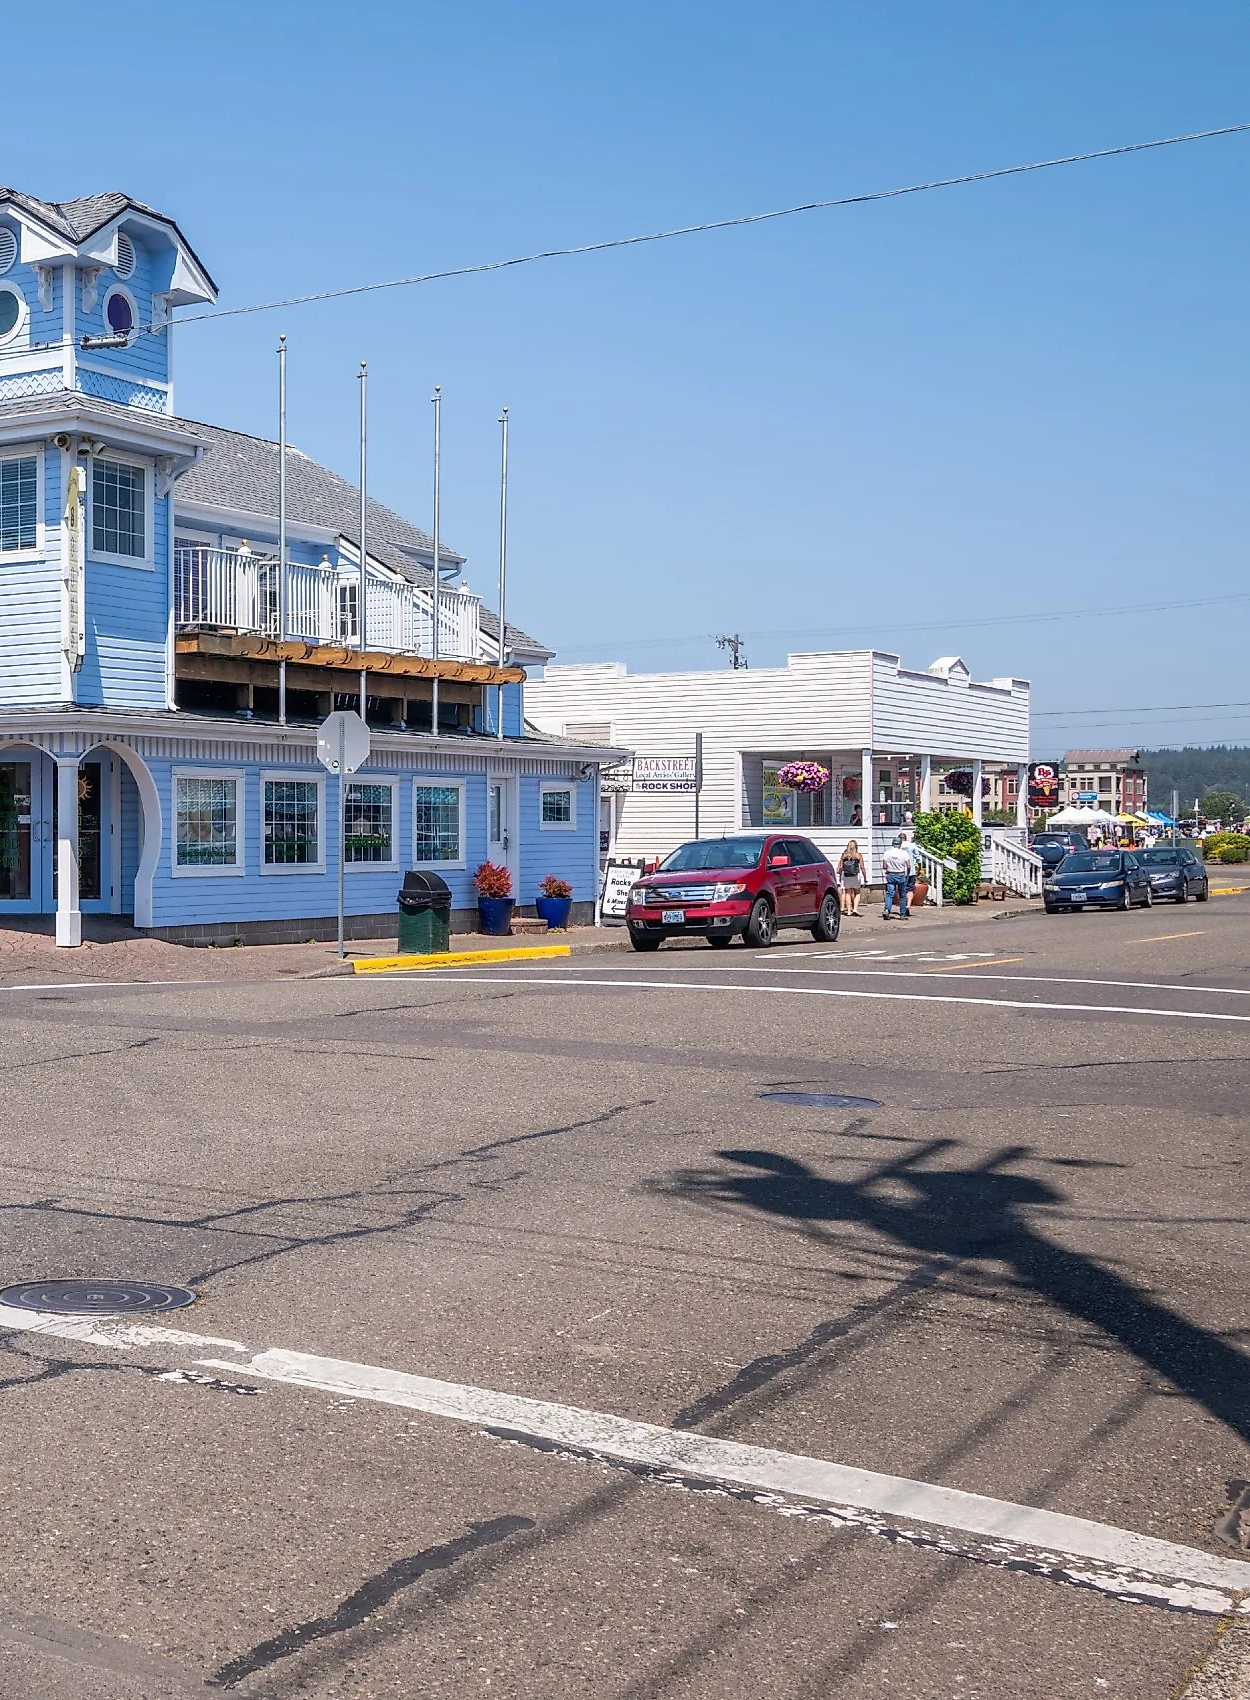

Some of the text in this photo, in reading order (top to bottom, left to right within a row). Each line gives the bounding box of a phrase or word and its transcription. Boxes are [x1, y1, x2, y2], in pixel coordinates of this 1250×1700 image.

[637, 759, 695, 771] BACKSTREET
[641, 782, 697, 790] ROCK SHOP
[611, 878, 632, 887] Rocks
[616, 889, 628, 897] She
